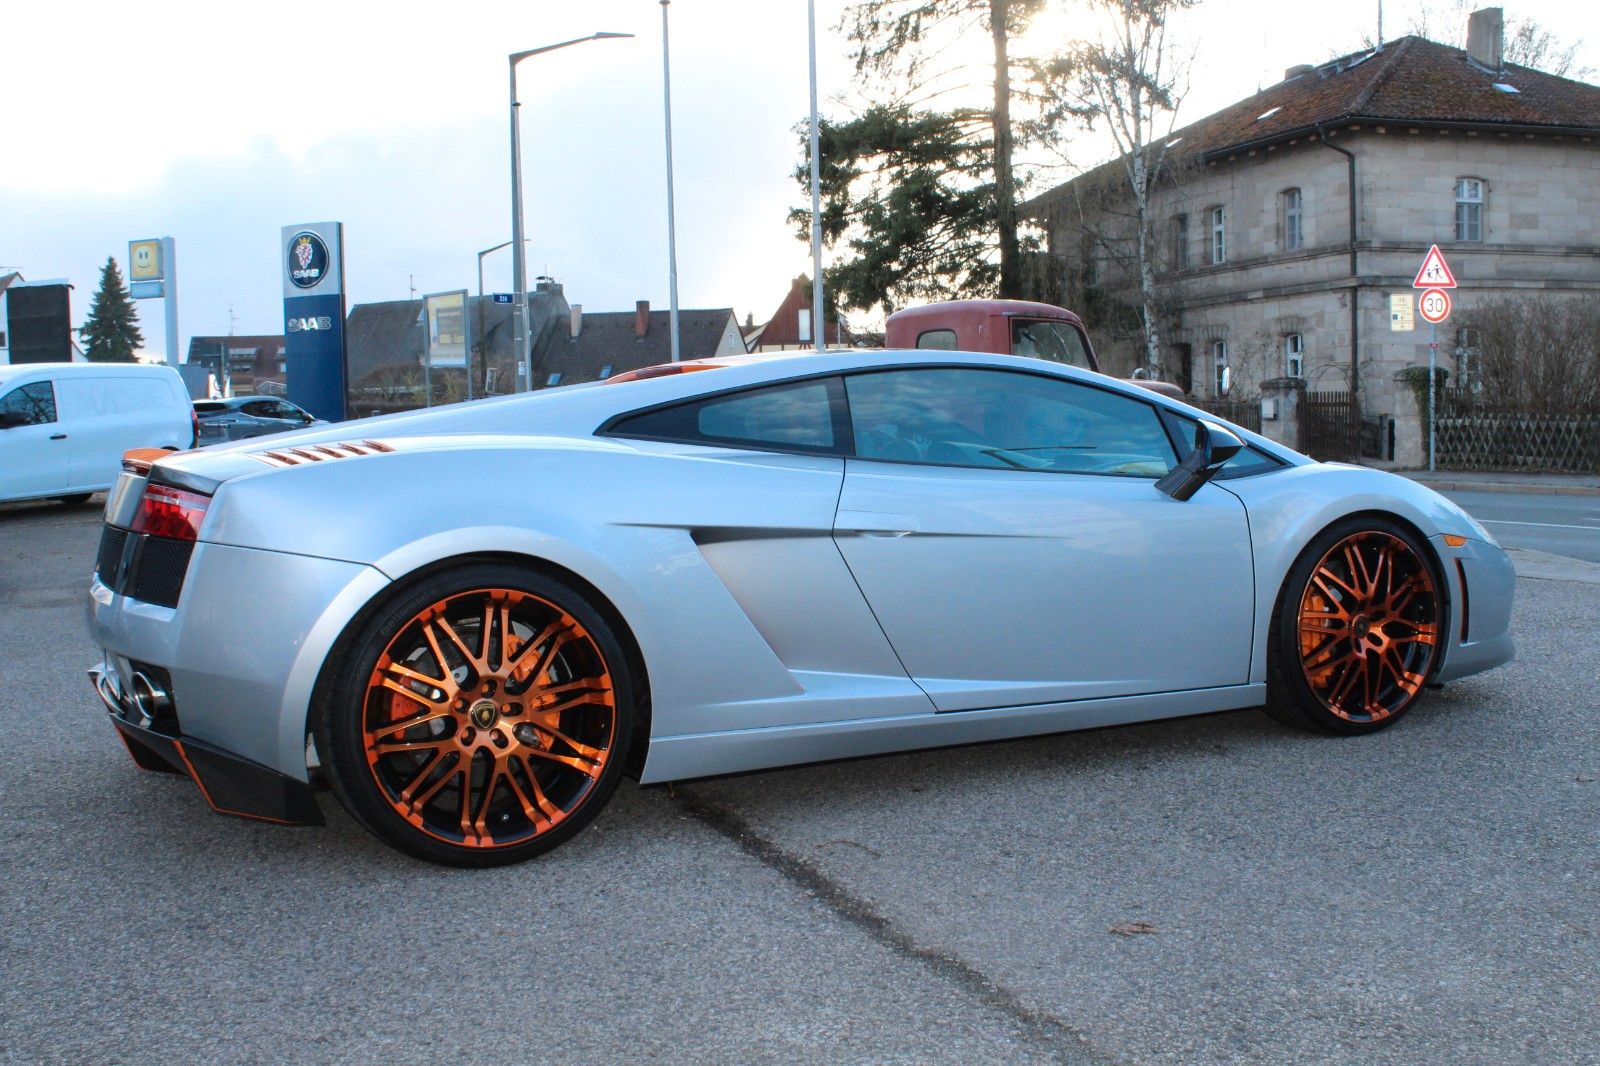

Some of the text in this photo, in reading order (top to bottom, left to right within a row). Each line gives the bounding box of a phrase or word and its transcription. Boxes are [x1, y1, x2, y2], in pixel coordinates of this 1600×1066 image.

[293, 268, 319, 279] SAAB
[1426, 298, 1443, 312] 30
[288, 316, 331, 333] SAAB
